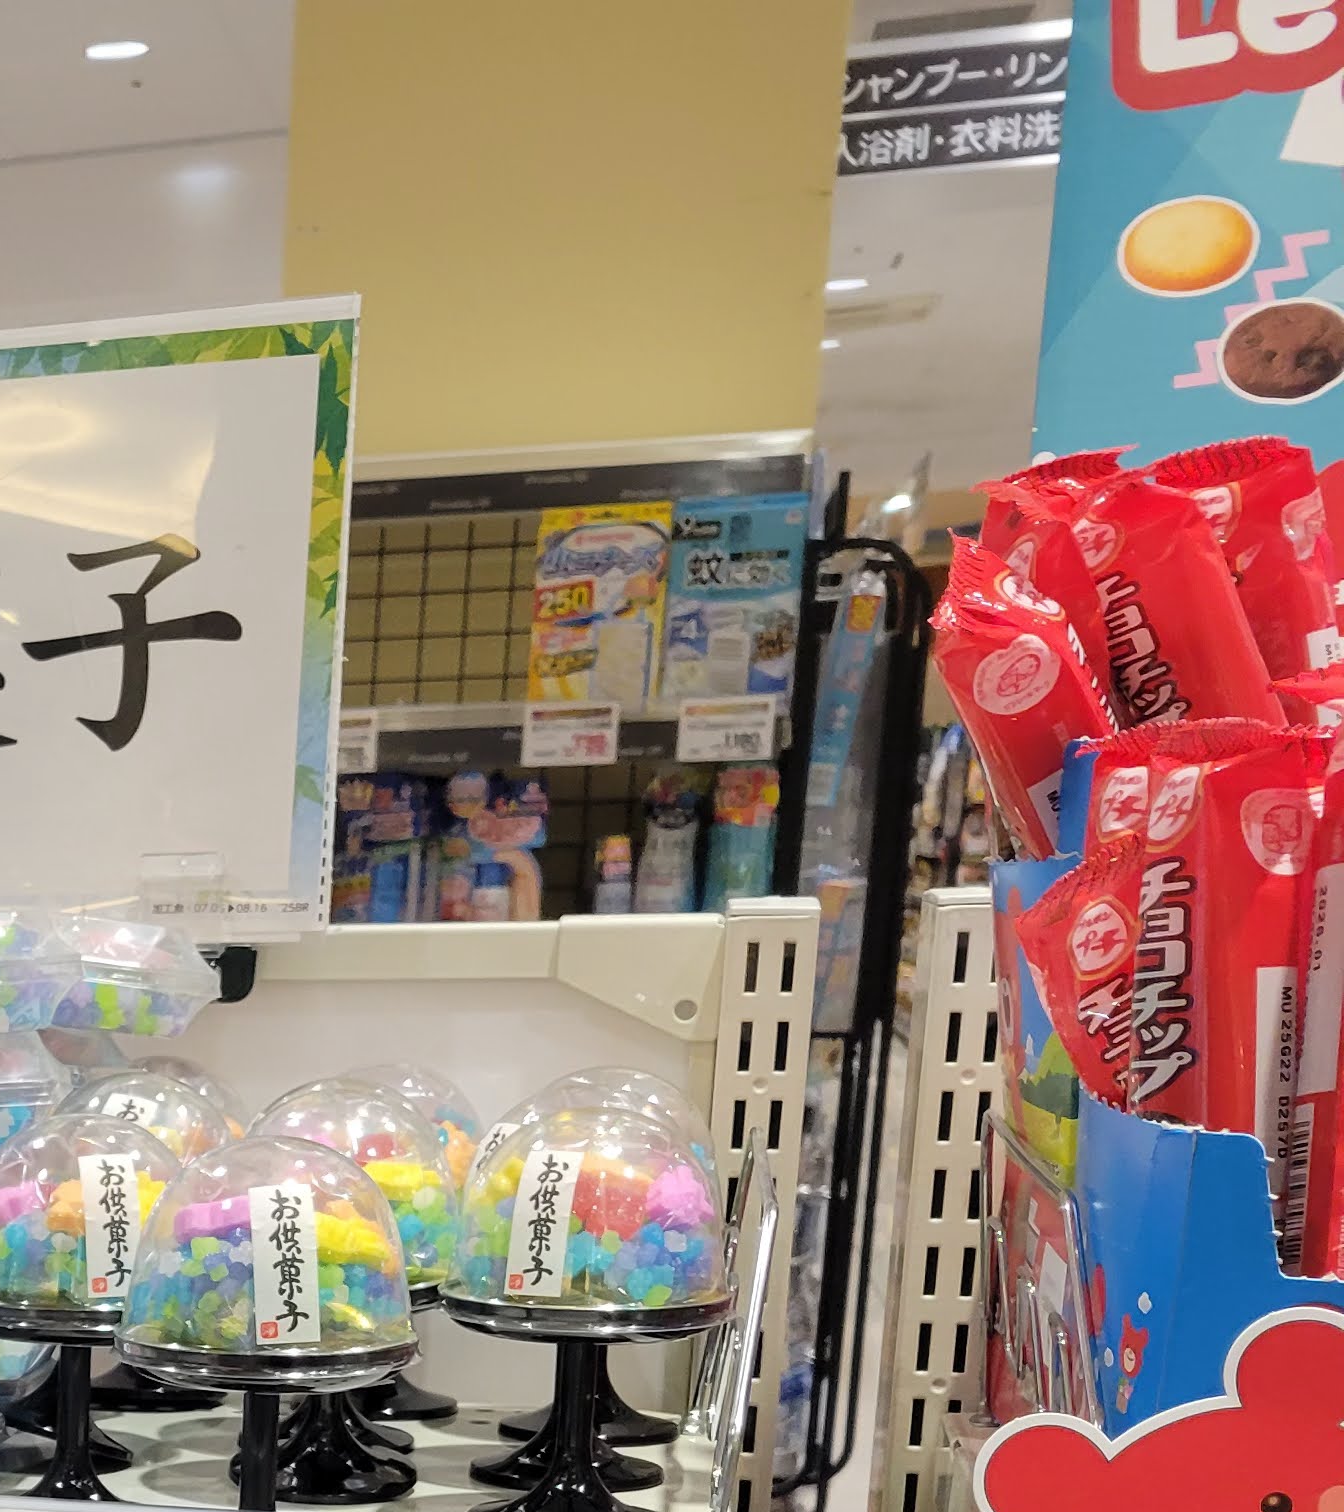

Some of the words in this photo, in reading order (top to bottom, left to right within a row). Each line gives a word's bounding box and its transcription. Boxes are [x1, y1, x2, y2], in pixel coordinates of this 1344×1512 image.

[1131, 860, 1193, 1101] チョコチップ
[98, 1157, 132, 1287] お供菓子
[267, 1188, 310, 1333] お供菓子
[522, 1153, 570, 1287] お供菓子
